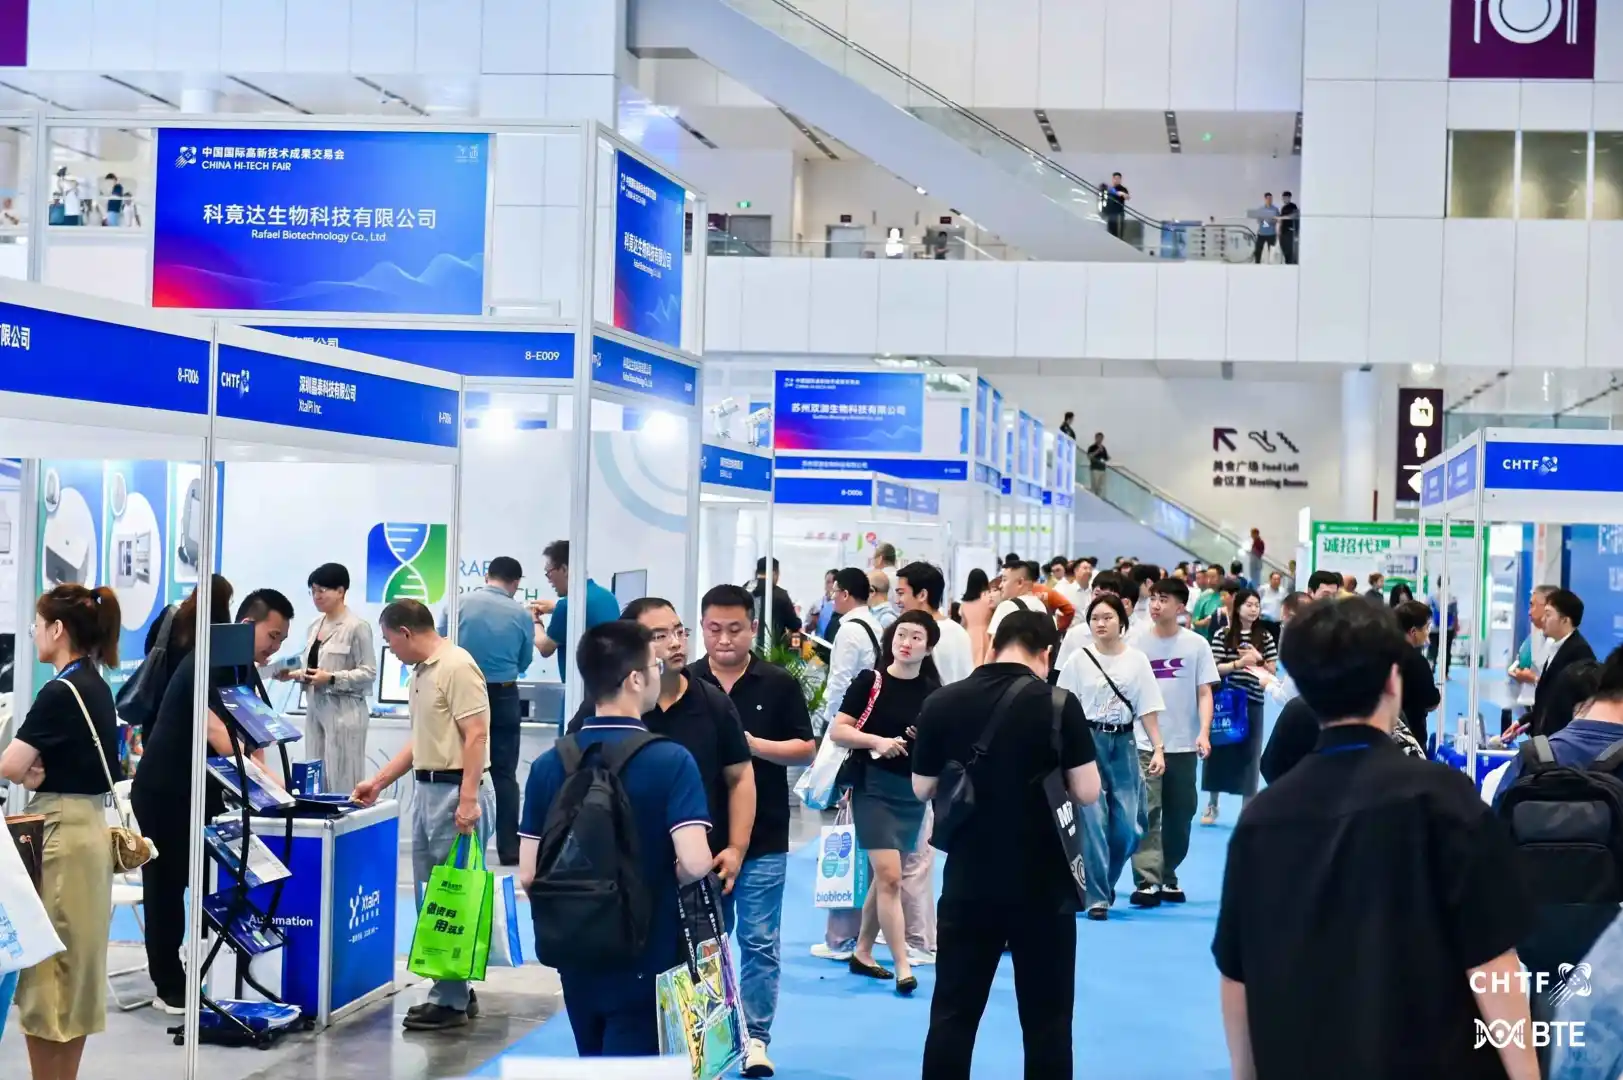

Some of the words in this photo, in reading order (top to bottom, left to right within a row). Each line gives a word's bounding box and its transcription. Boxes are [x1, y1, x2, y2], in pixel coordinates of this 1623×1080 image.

[202, 147, 345, 161] 中国国际高新技术成果交易会
[201, 161, 232, 171] CHINA
[234, 161, 269, 171] HI-TECH
[271, 162, 291, 171] FAIR
[203, 204, 437, 230] 科竟达生物科技有限公司
[251, 230, 281, 240] Rafael
[282, 230, 350, 244] Biotechnology
[524, 351, 560, 361] 8-E009
[177, 367, 200, 385] 8-F006
[220, 371, 241, 388] CHTF
[1213, 460, 1259, 472] 美食广场
[1262, 462, 1282, 472] Food
[1502, 458, 1539, 470] CHTF
[1213, 475, 1246, 487] 会议室
[1249, 477, 1282, 489] Meeting
[1323, 536, 1391, 554] 诚招代理
[816, 890, 853, 903] bioblock
[249, 914, 314, 927] Aumation
